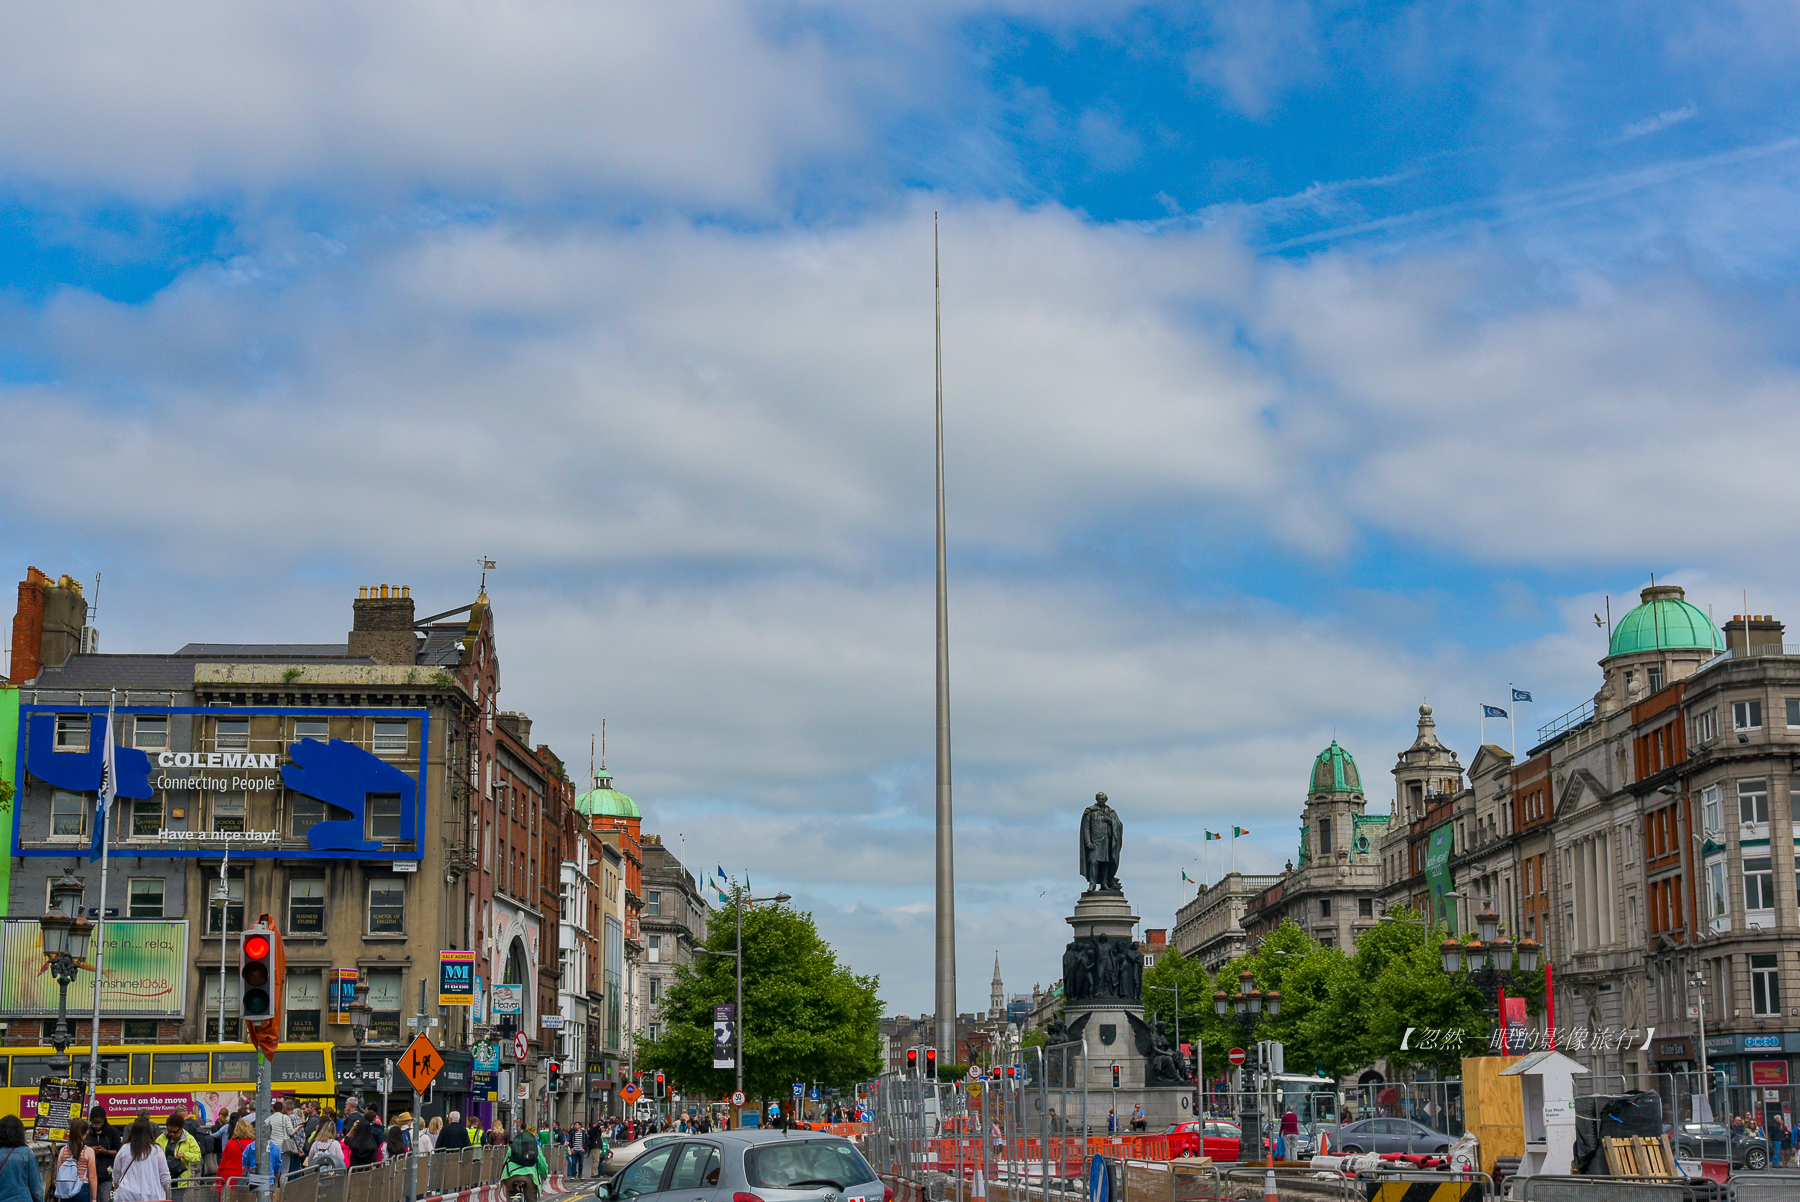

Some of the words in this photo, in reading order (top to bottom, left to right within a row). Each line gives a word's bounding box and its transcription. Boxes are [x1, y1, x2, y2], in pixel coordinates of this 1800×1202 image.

[158, 752, 276, 768] COLEMAN
[157, 775, 227, 792] Connecting
[233, 776, 275, 792] People
[158, 828, 193, 840] Have
[198, 831, 206, 840] a
[211, 829, 240, 840] nice
[245, 829, 276, 844] day!
[145, 939, 175, 952] relax
[140, 978, 168, 989] 106.8
[494, 999, 520, 1011] Heaven
[343, 1071, 381, 1080] COFEE
[130, 1097, 136, 1105] it
